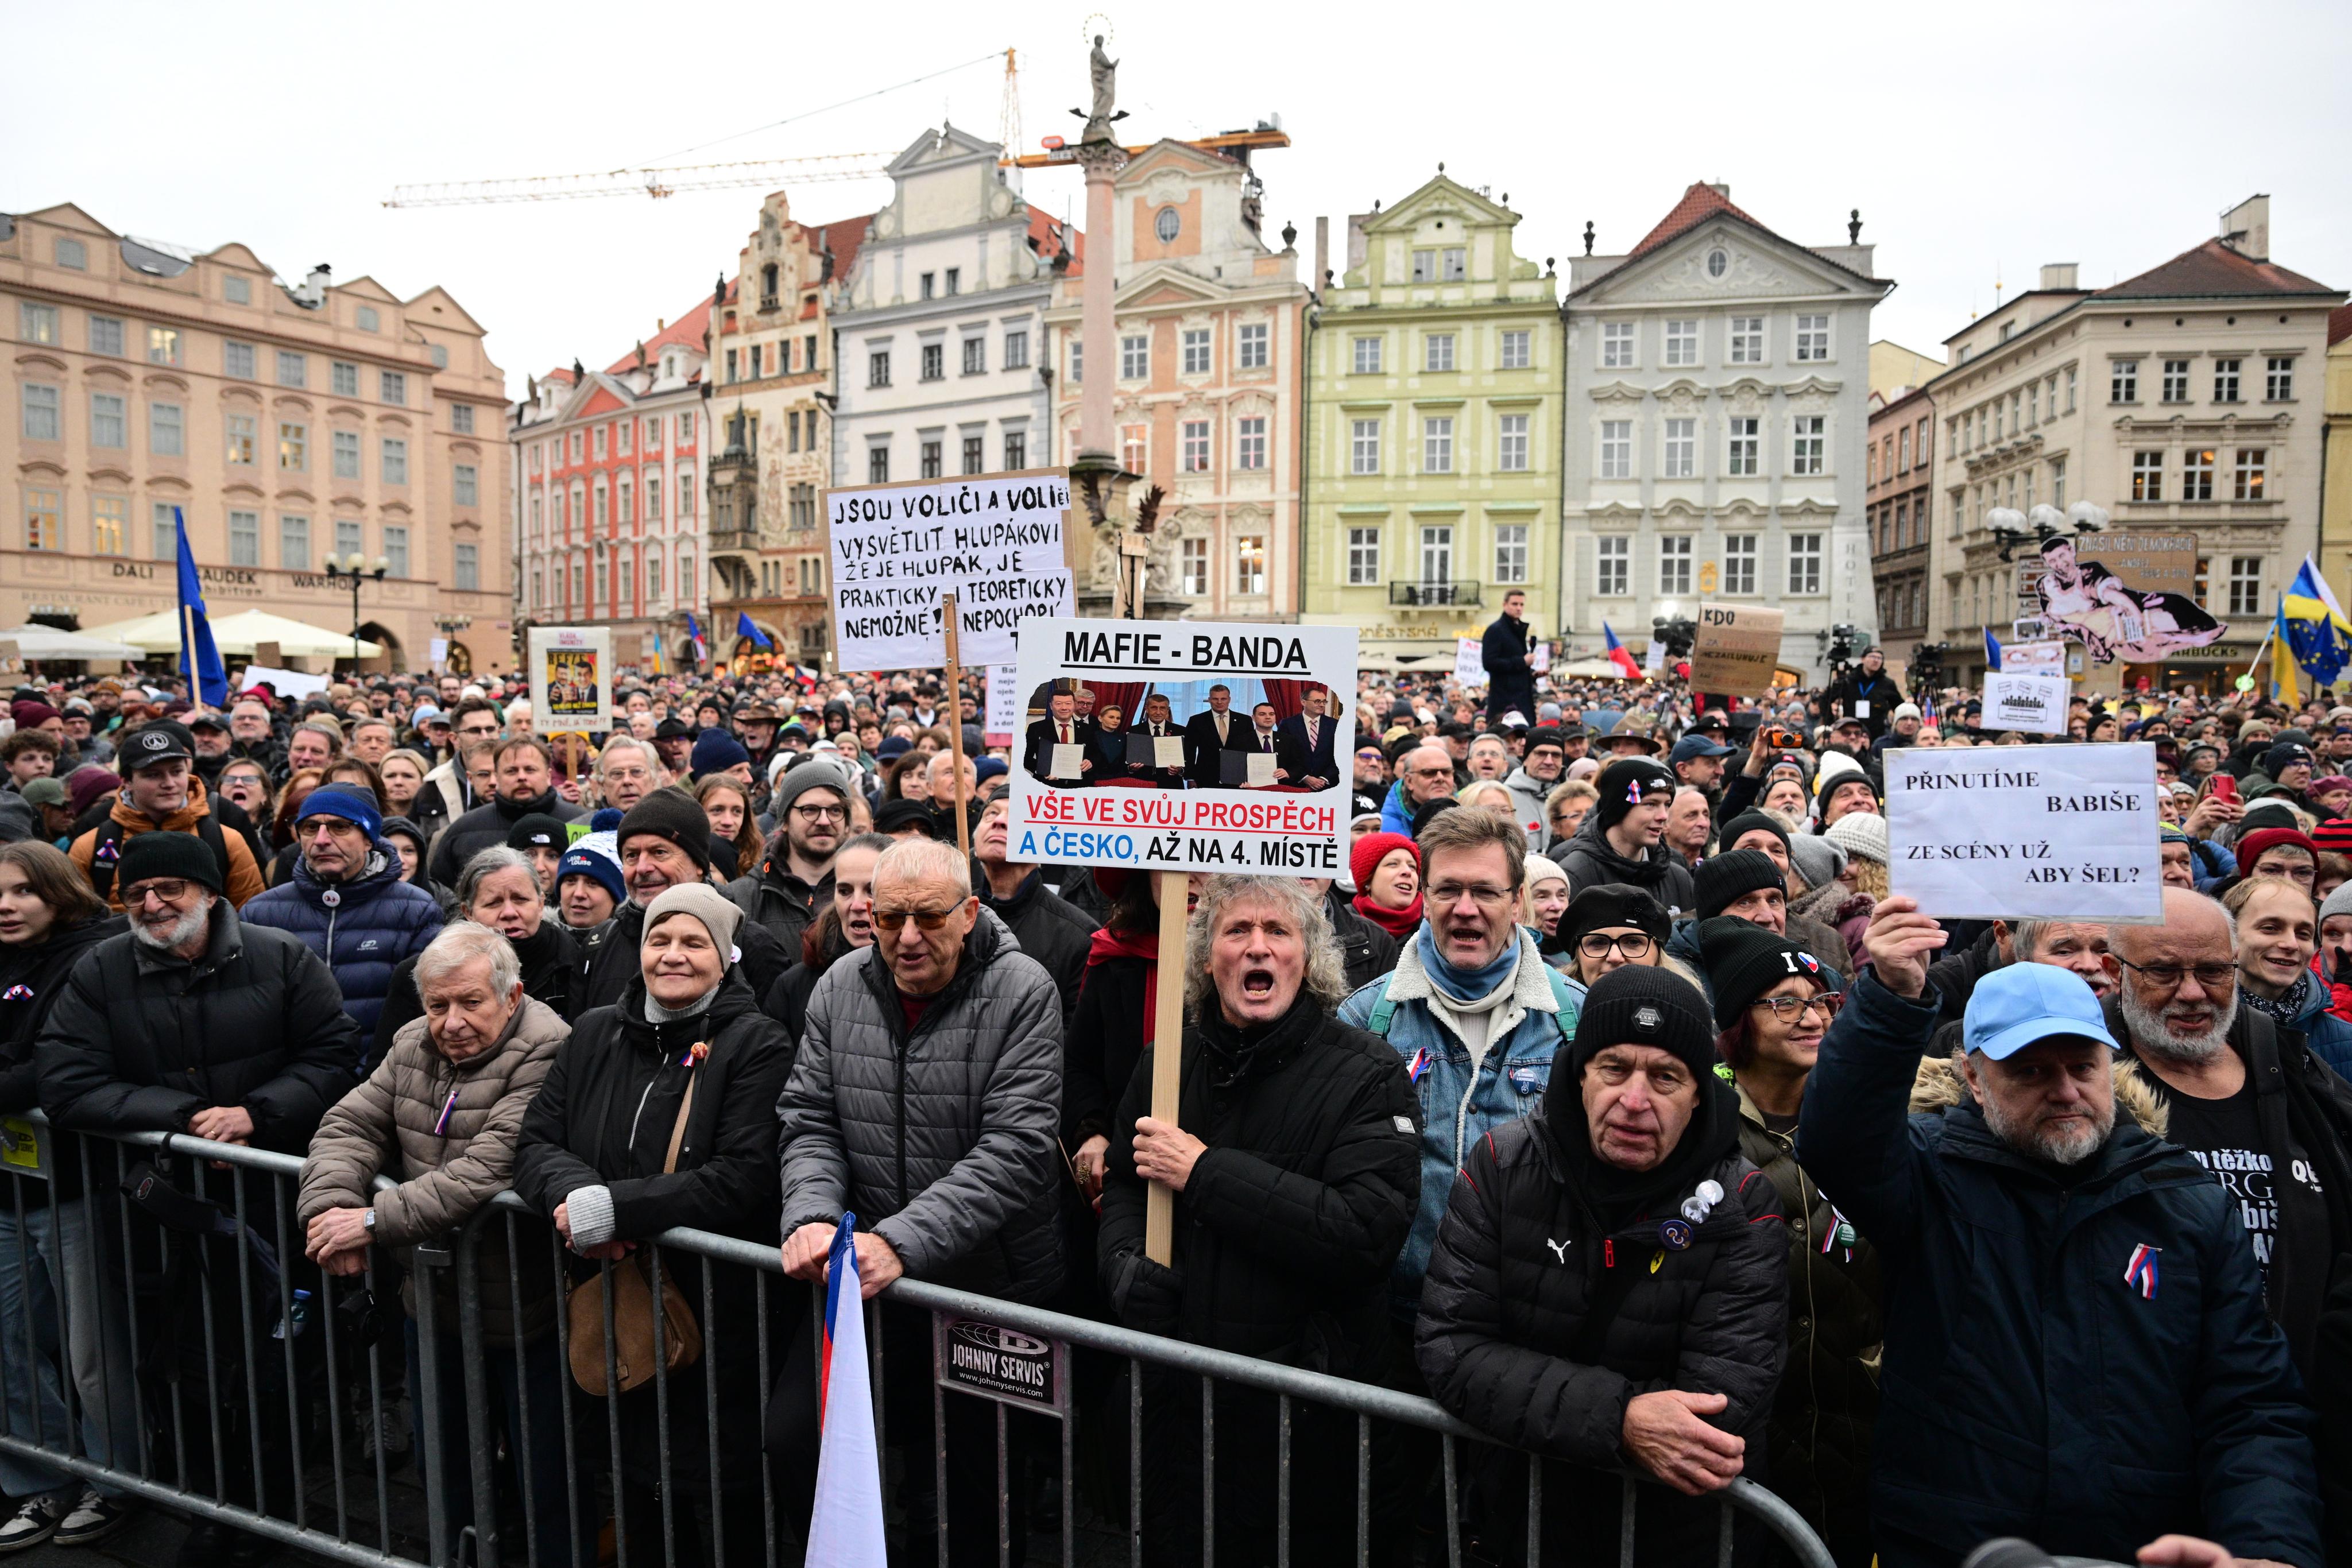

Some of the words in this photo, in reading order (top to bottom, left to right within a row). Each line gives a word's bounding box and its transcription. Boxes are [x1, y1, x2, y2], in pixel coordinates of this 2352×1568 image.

[835, 498, 891, 524] JSOU
[903, 486, 980, 517] VOLIČI
[988, 491, 998, 509] A
[839, 526, 943, 560] VYSVĚTLIT
[955, 518, 1058, 549] HLUPÁKOVI
[198, 567, 257, 585] AUDEK
[845, 560, 869, 580] ŽE
[876, 560, 894, 577] JE
[903, 550, 991, 577] HLUPÁK,
[997, 551, 1023, 572] JE
[841, 586, 937, 609] PRAKTICKY
[968, 576, 1066, 603] TEORETICKY
[1704, 609, 1735, 626] KDO
[1065, 632, 1161, 664] MAFIE
[1192, 636, 1307, 668] BANDA
[1905, 769, 2040, 790] PŘINUTÍME
[1027, 790, 1074, 820] VŠE
[1083, 797, 1115, 822] VE
[1123, 793, 1186, 824] SVŮJ
[1195, 800, 1334, 831] PROSPĚCH
[2046, 791, 2141, 812] BABIŠE
[1019, 831, 1037, 855] A
[1045, 826, 1139, 864] ČESKO,
[1146, 831, 1181, 861] AŽ
[1189, 838, 1224, 864] NA
[1231, 840, 1251, 865] 4.
[1260, 836, 1338, 869] MÍSTĚ
[1908, 846, 1934, 860] ZE
[1941, 841, 2014, 860] SCÉNY
[2021, 840, 2052, 859] UŽ
[2025, 868, 2074, 882] ABY
[2082, 863, 2140, 883] ŠEL?
[1780, 951, 1798, 973] I
[2211, 1148, 2273, 1171] těžko
[2236, 1199, 2278, 1230] biš
[952, 1344, 997, 1375] JOHNNY
[959, 1372, 1043, 1398] www.johnnyservis.com
